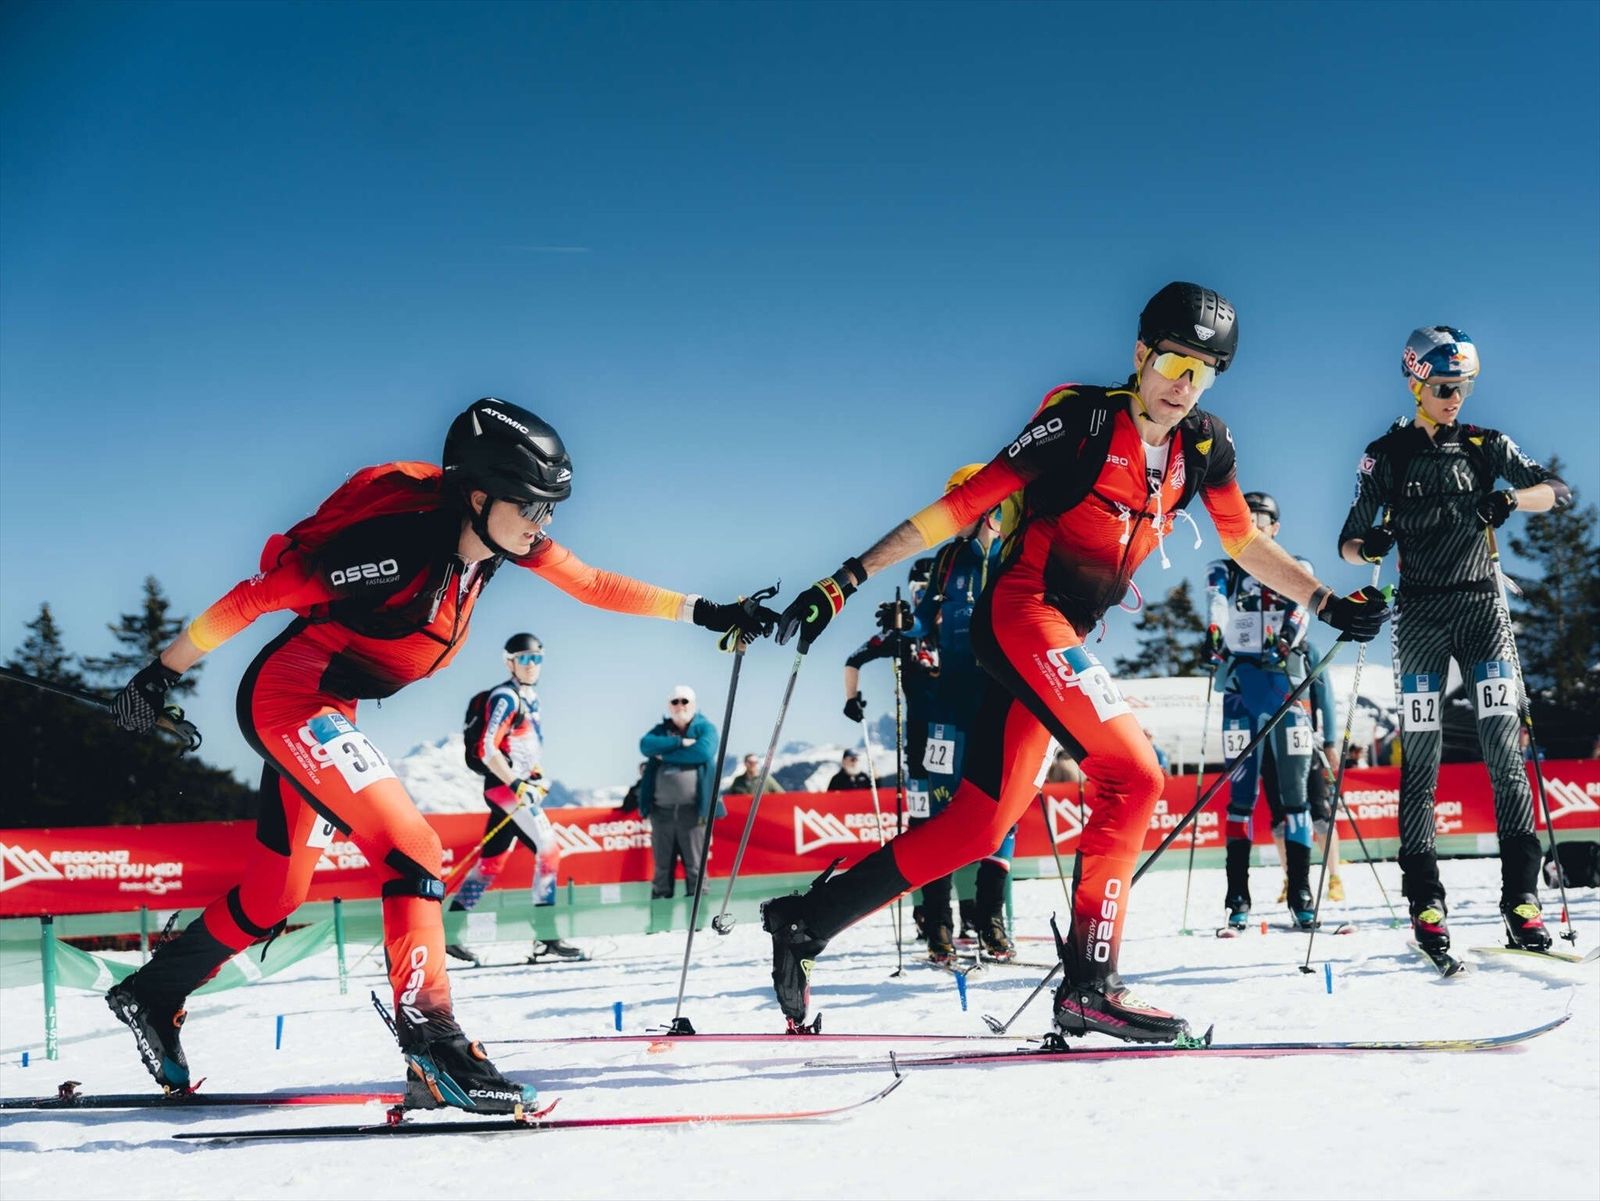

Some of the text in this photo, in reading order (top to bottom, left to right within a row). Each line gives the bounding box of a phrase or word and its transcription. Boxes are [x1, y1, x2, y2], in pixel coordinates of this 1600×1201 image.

[481, 407, 529, 434] ATOMIC
[1483, 684, 1508, 708] 6.2
[1411, 698, 1435, 723] 6.2
[1227, 734, 1245, 752] 5.2
[1292, 730, 1310, 749] 5.2
[341, 738, 386, 773] 3.1
[929, 745, 948, 767] 2.2
[64, 862, 183, 879] DENTS DU MIDI
[468, 1089, 522, 1103] SCARPA
